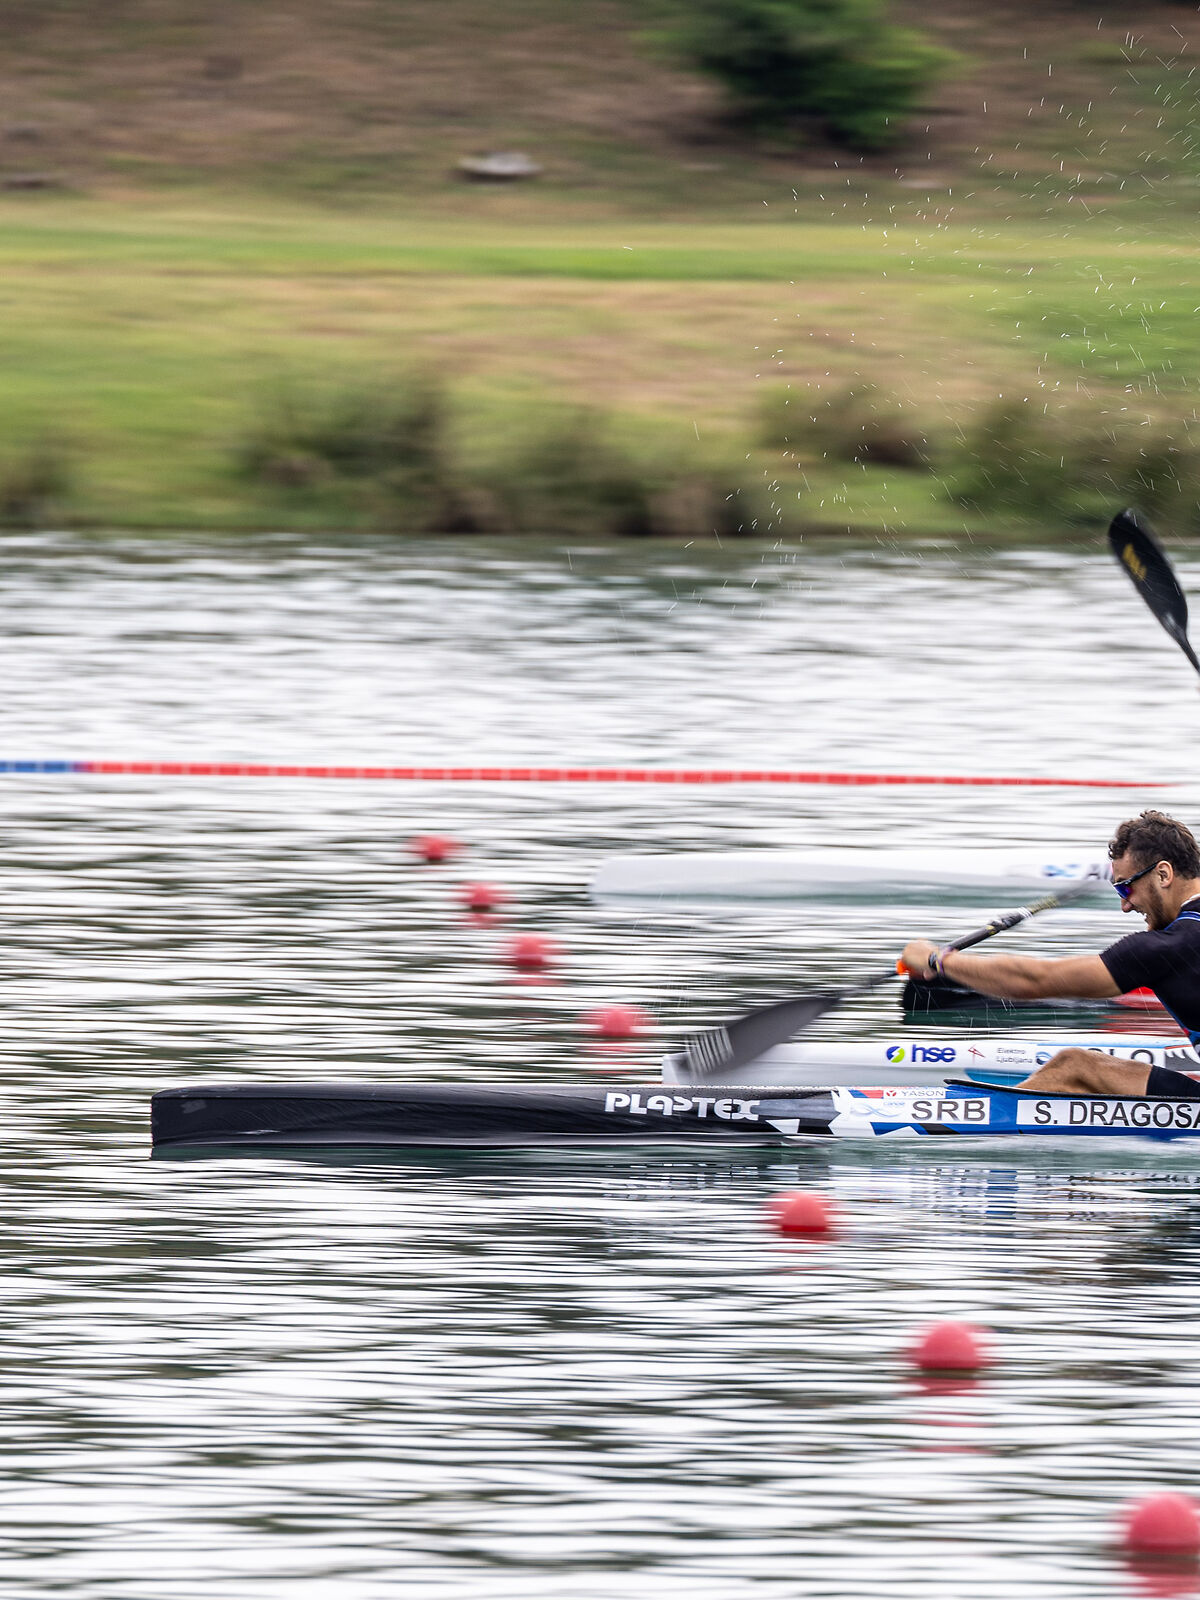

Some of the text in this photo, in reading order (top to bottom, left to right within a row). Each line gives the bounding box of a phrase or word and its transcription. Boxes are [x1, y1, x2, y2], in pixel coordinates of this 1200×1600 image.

[911, 1044, 957, 1063] hse
[997, 1047, 1026, 1055] Elektro
[901, 1089, 944, 1097] YASON
[604, 1092, 761, 1121] PLASTEX
[911, 1100, 986, 1121] SRB
